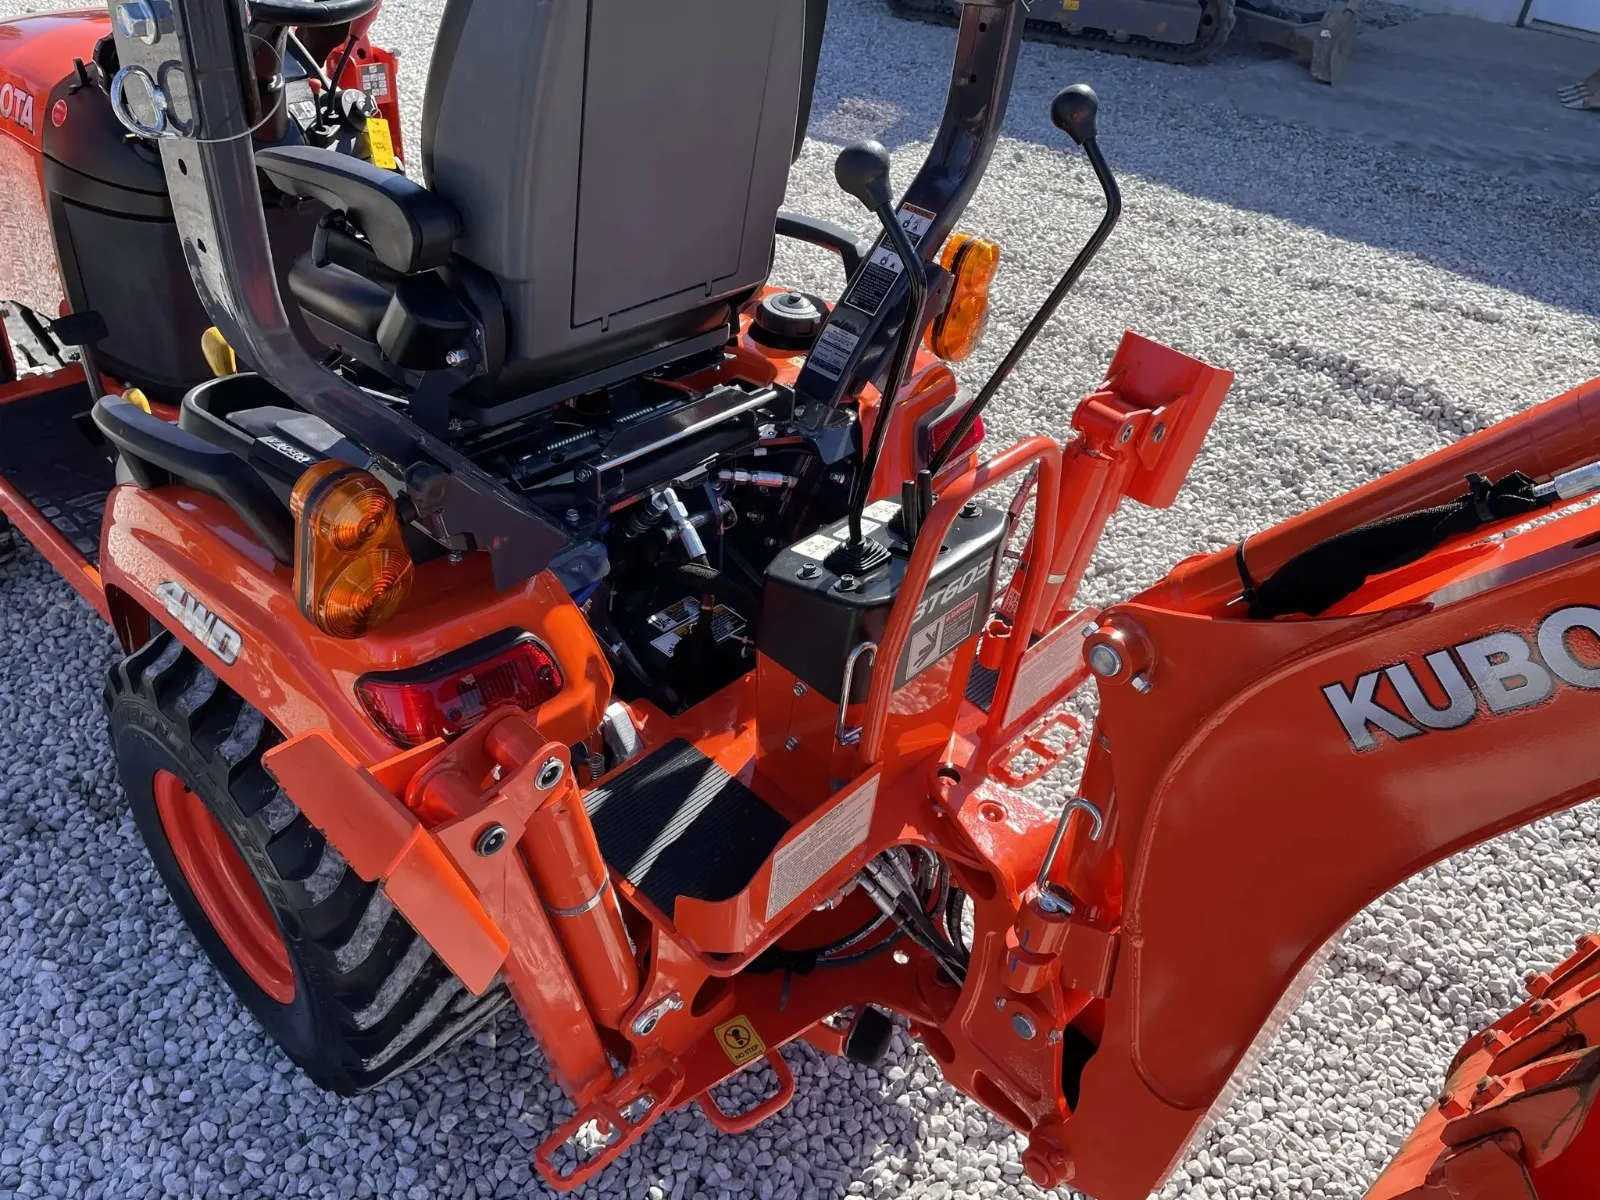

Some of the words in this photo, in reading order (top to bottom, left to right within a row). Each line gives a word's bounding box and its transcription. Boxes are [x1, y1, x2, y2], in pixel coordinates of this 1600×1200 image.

[157, 581, 243, 666] 4WD
[1321, 605, 1600, 750] KUBO
[734, 1052, 745, 1061] NO
[744, 1044, 759, 1055] STEP
